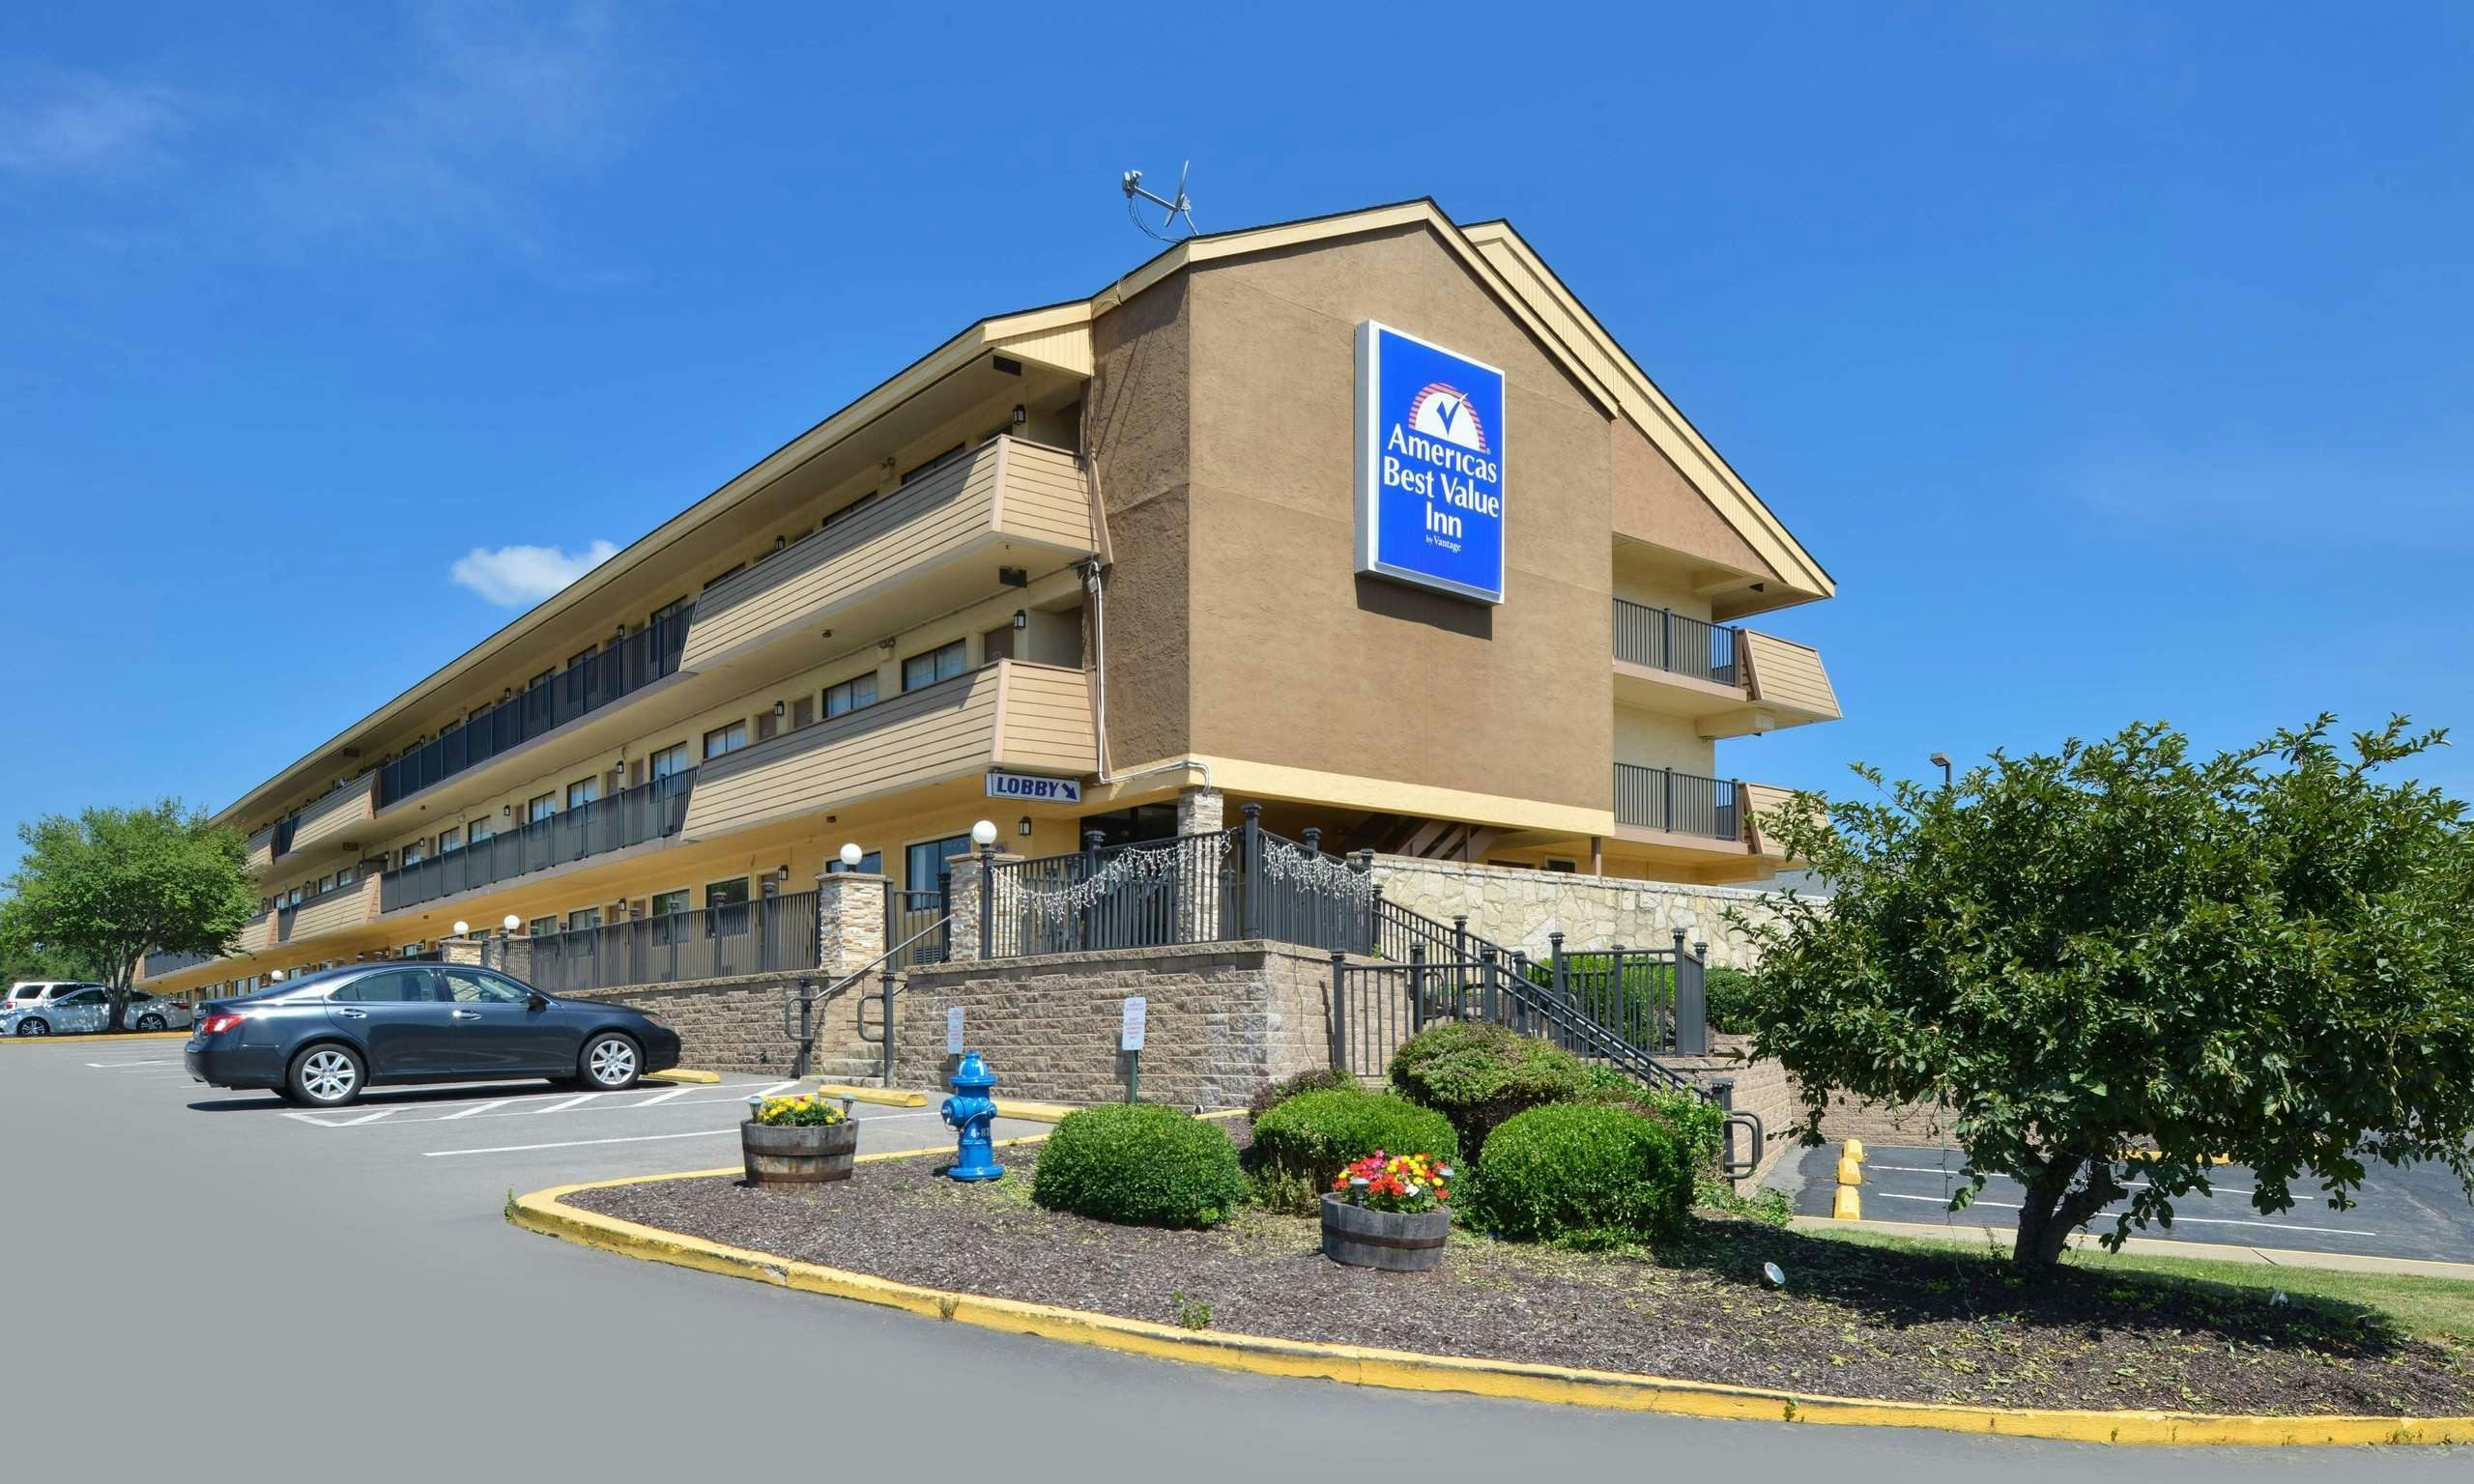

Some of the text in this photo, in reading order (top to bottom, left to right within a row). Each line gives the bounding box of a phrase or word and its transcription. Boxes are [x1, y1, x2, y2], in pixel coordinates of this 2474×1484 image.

[1388, 423, 1498, 484] Americas
[1384, 456, 1500, 518] Best Value
[1425, 501, 1462, 538] Inn
[1425, 534, 1461, 554] by Vantage
[996, 777, 1059, 797] LOBBY
